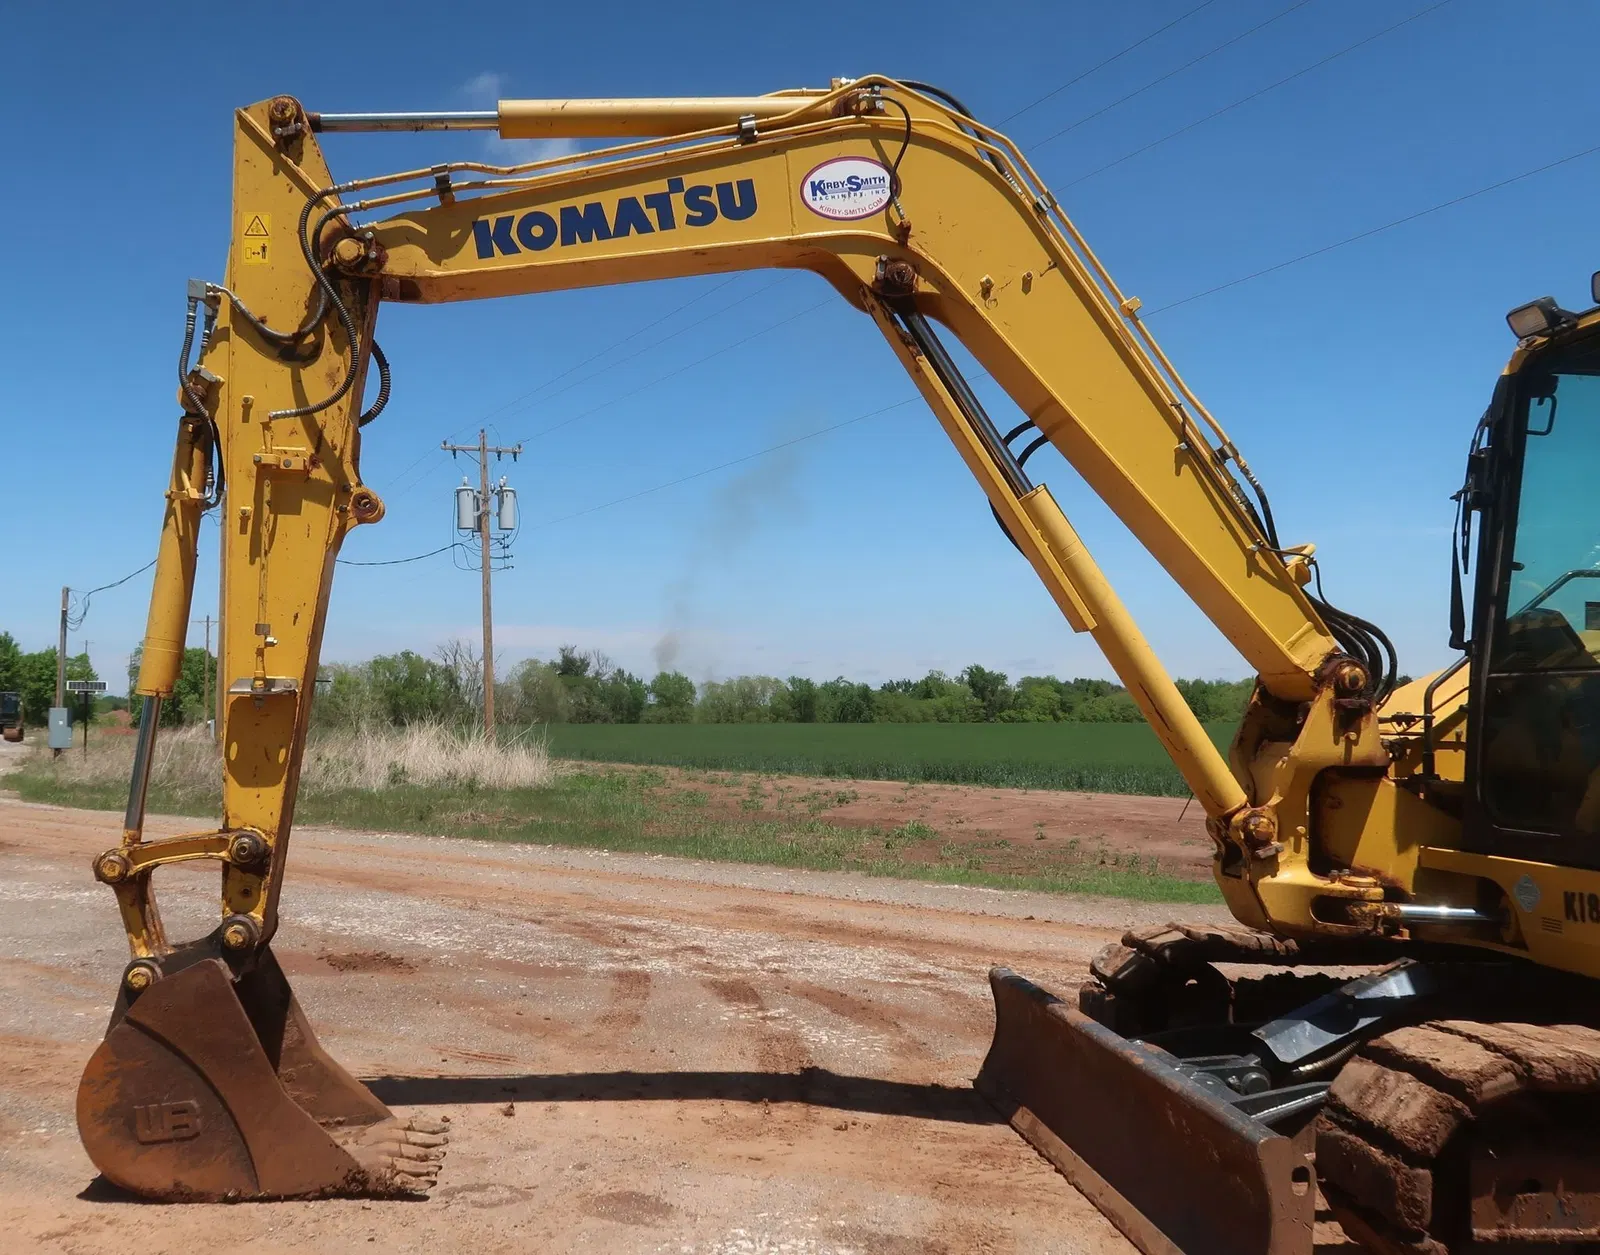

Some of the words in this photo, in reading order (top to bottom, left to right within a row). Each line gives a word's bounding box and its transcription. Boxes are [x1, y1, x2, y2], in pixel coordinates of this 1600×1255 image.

[810, 175, 886, 197] KIRBY-SMITH
[473, 177, 758, 258] KOMATSU
[819, 197, 885, 216] KIRBY-SMITH.COM
